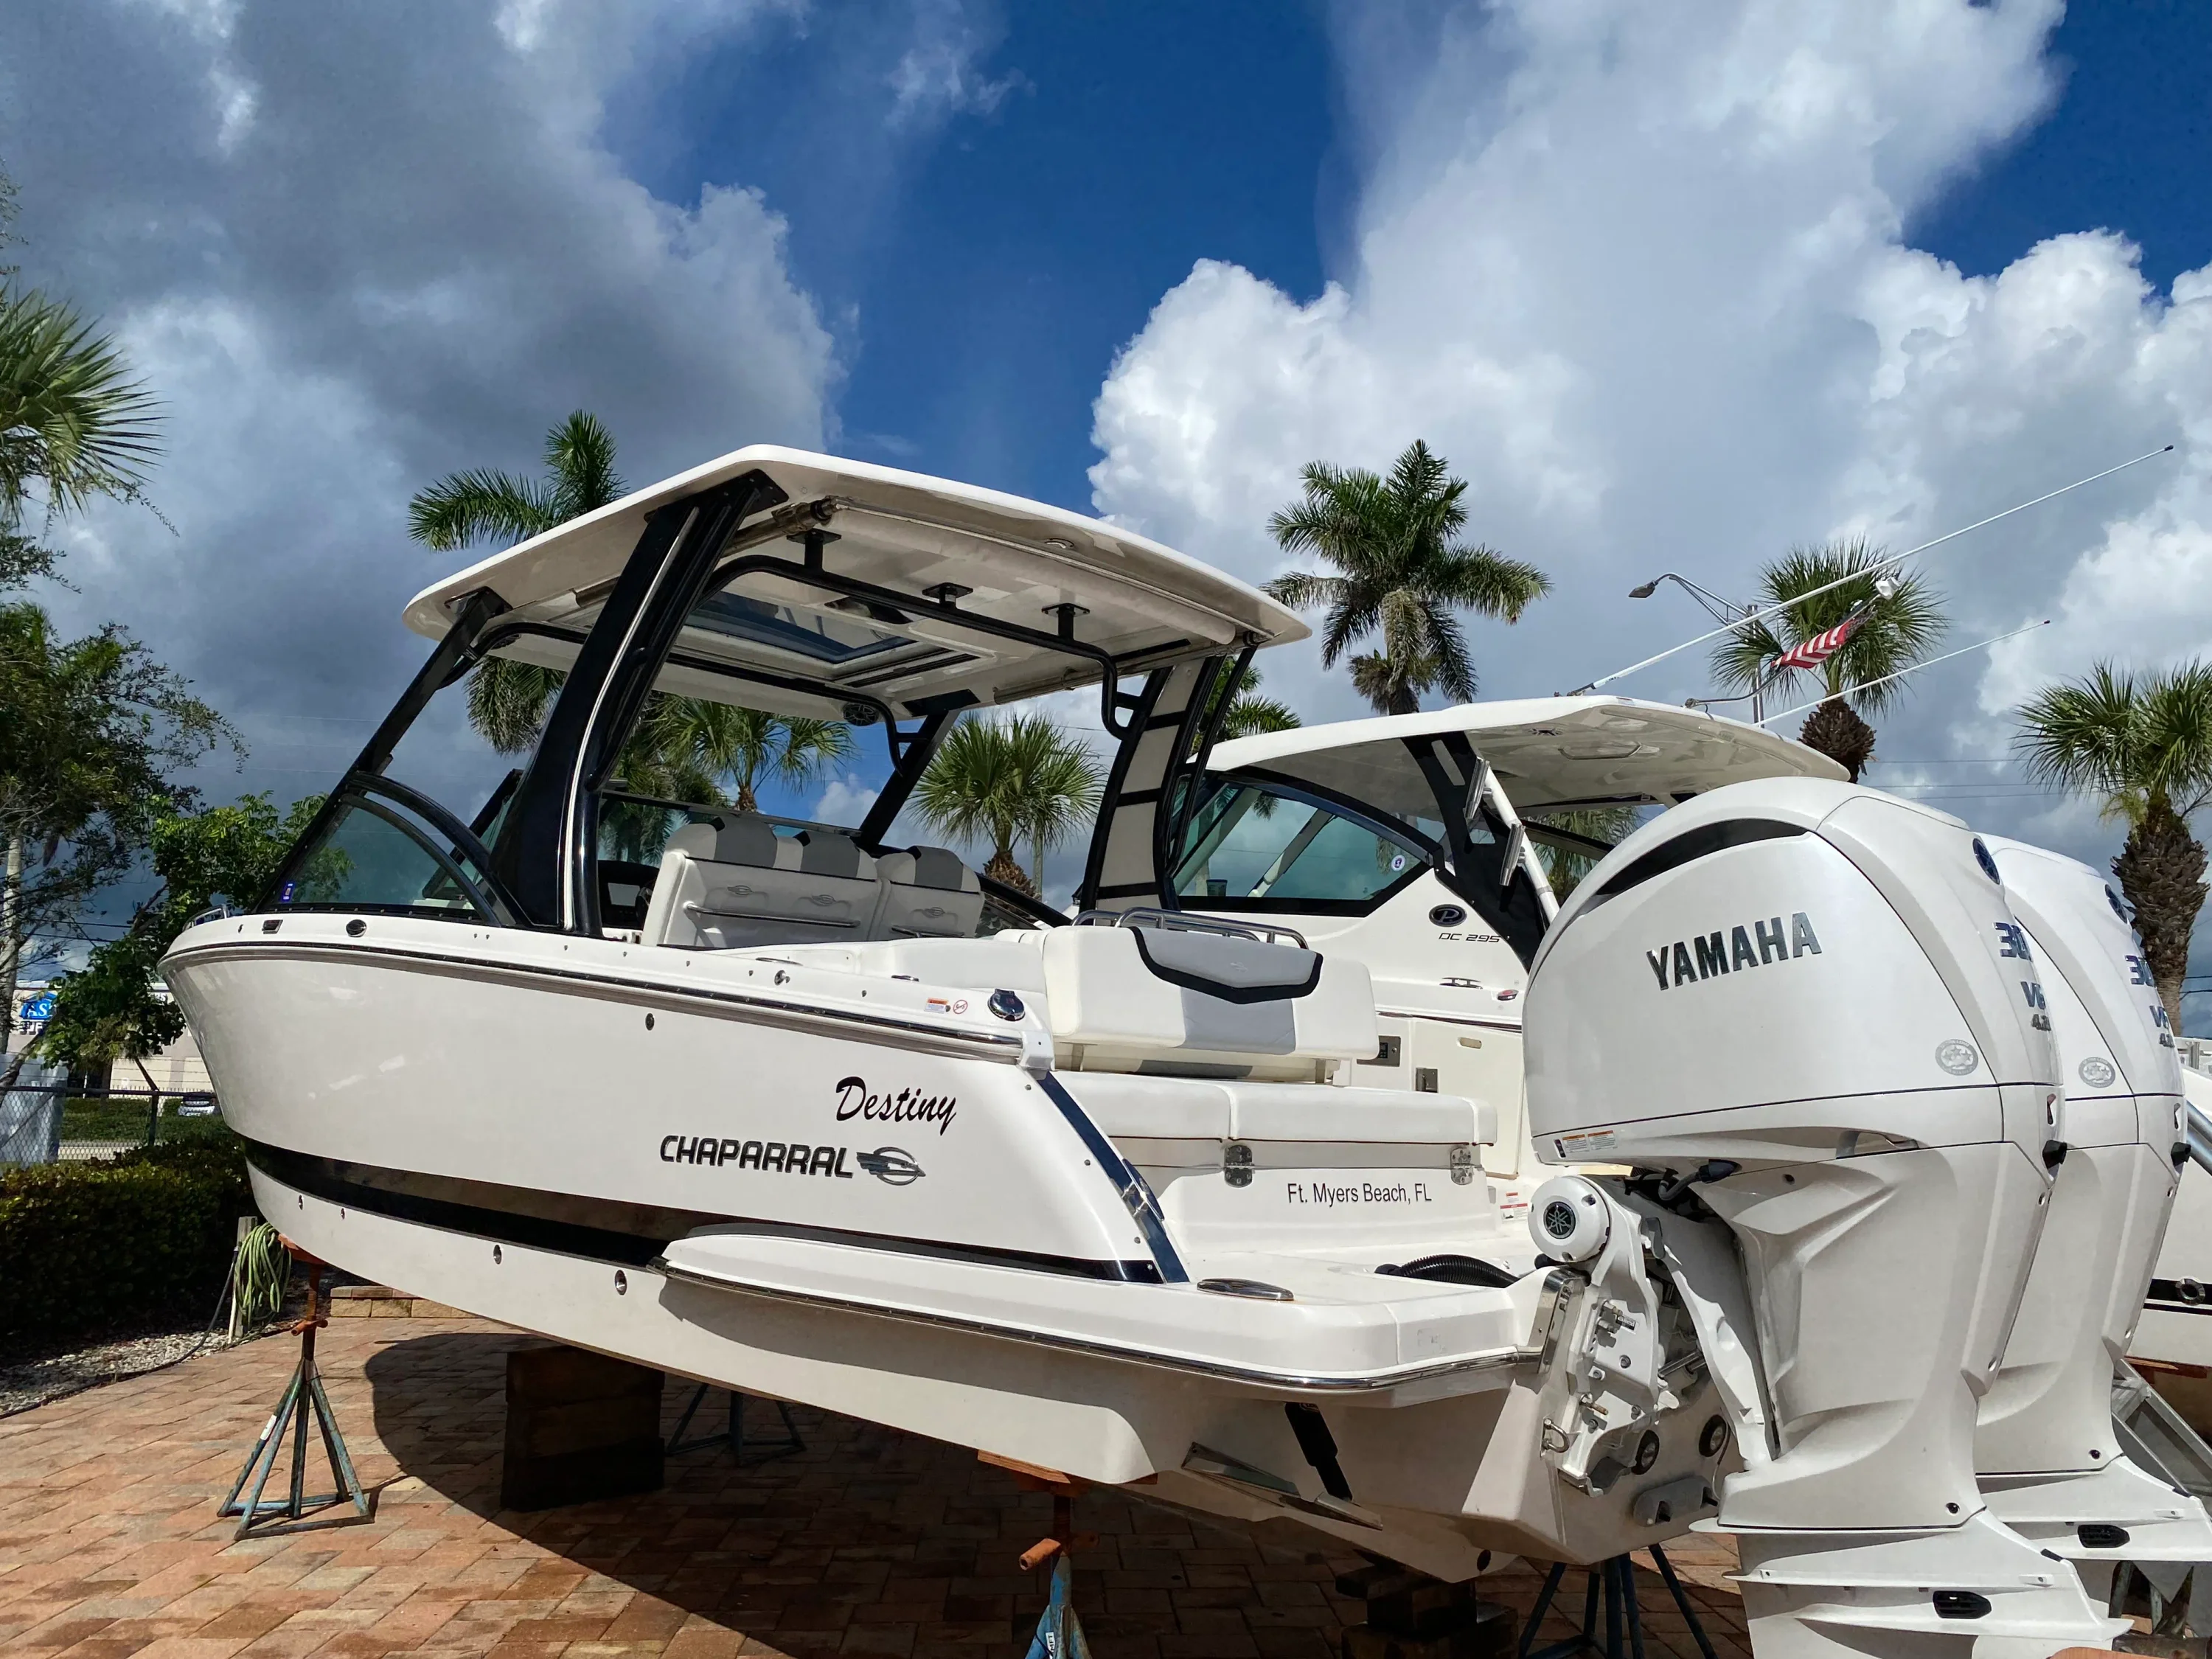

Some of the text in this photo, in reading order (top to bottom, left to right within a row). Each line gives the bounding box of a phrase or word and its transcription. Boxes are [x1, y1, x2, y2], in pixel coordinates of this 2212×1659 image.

[1439, 932, 1501, 943] DC 295
[1646, 911, 1823, 991] YAMAHA
[1992, 922, 2032, 962] 30
[835, 1076, 957, 1136] Destiny
[660, 1135, 854, 1179] CHAPARRAL
[1287, 1183, 1432, 1208] Ft. Myers Beach, FL
